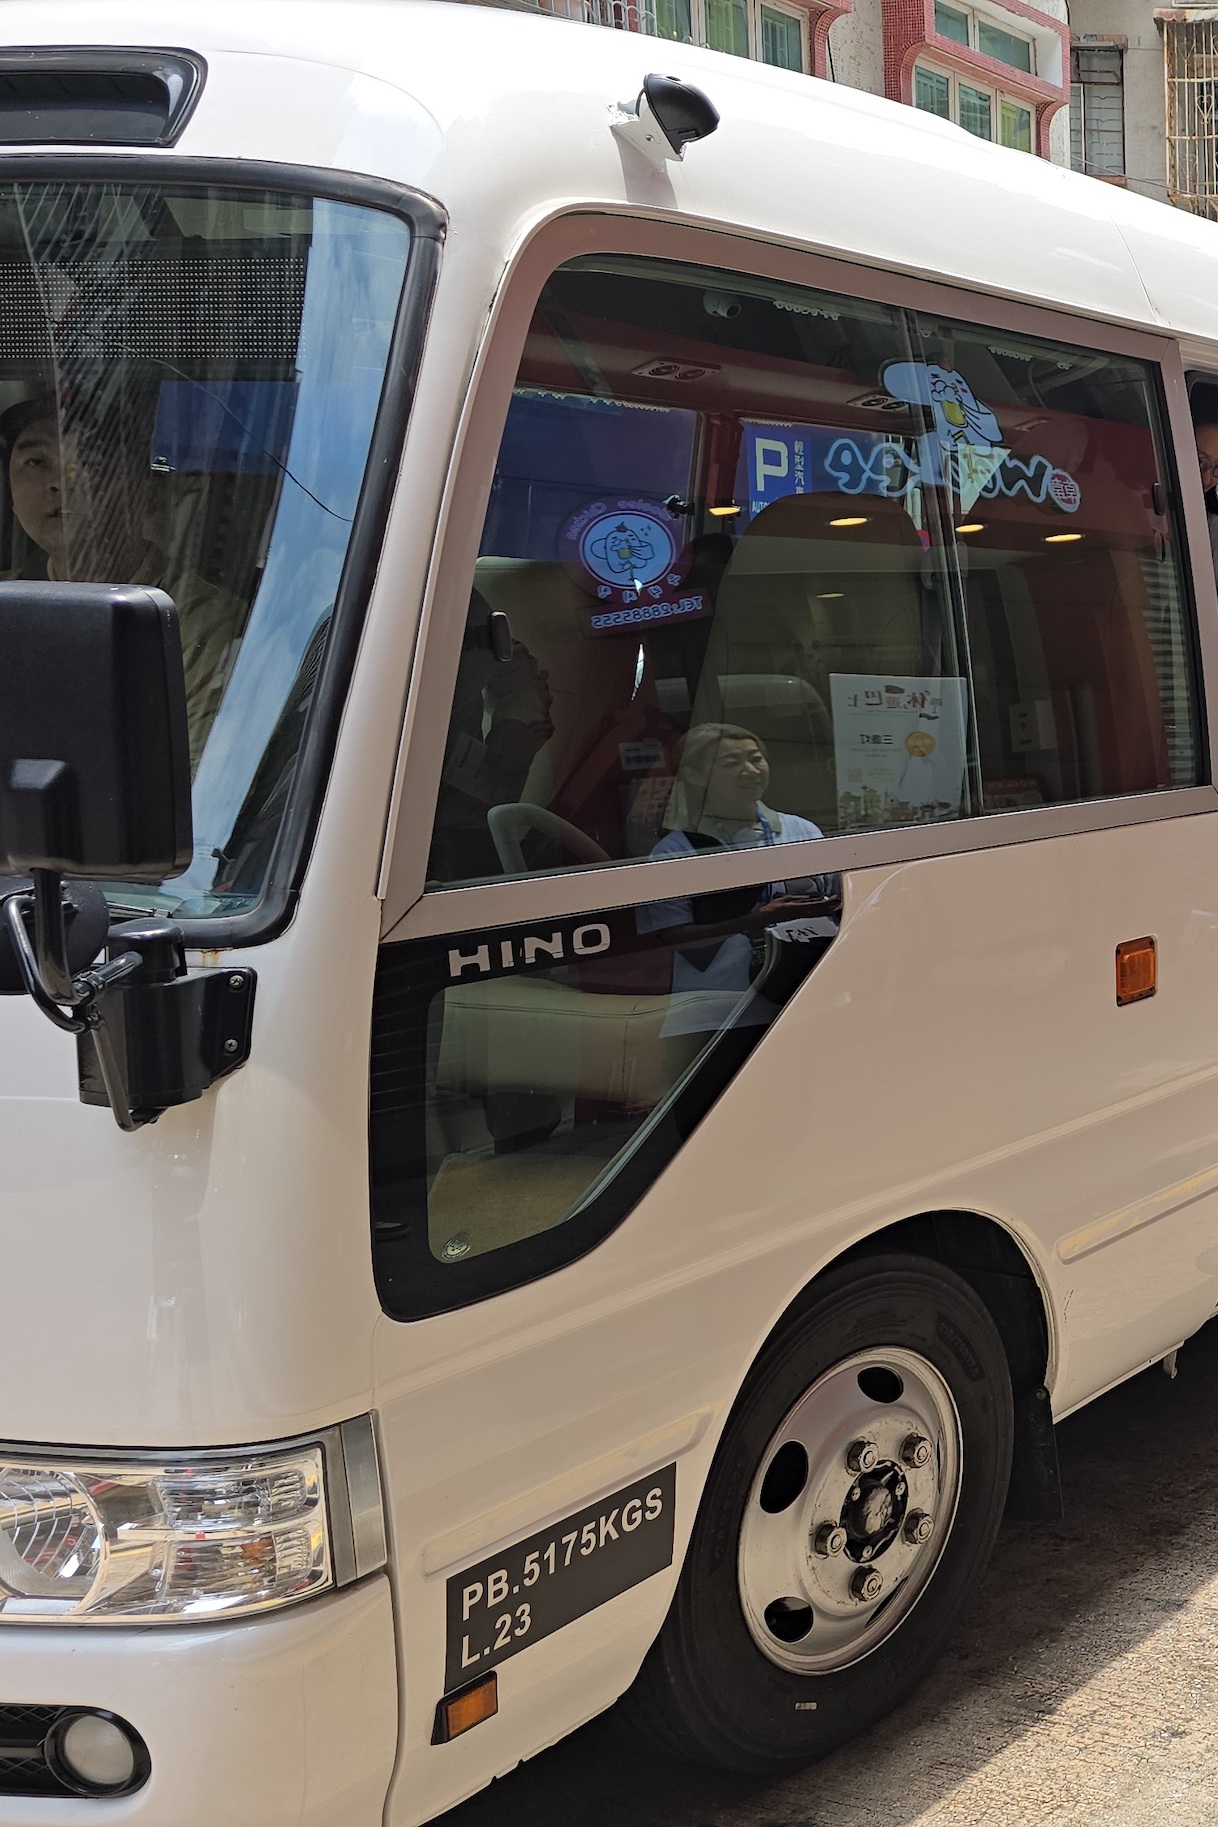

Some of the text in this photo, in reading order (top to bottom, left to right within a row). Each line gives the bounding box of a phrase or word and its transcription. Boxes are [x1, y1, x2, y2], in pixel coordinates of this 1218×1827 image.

[755, 437, 788, 491] P
[448, 923, 611, 977] HINO
[462, 1487, 663, 1622] PB.5175KGS
[461, 1602, 532, 1669] L.23
